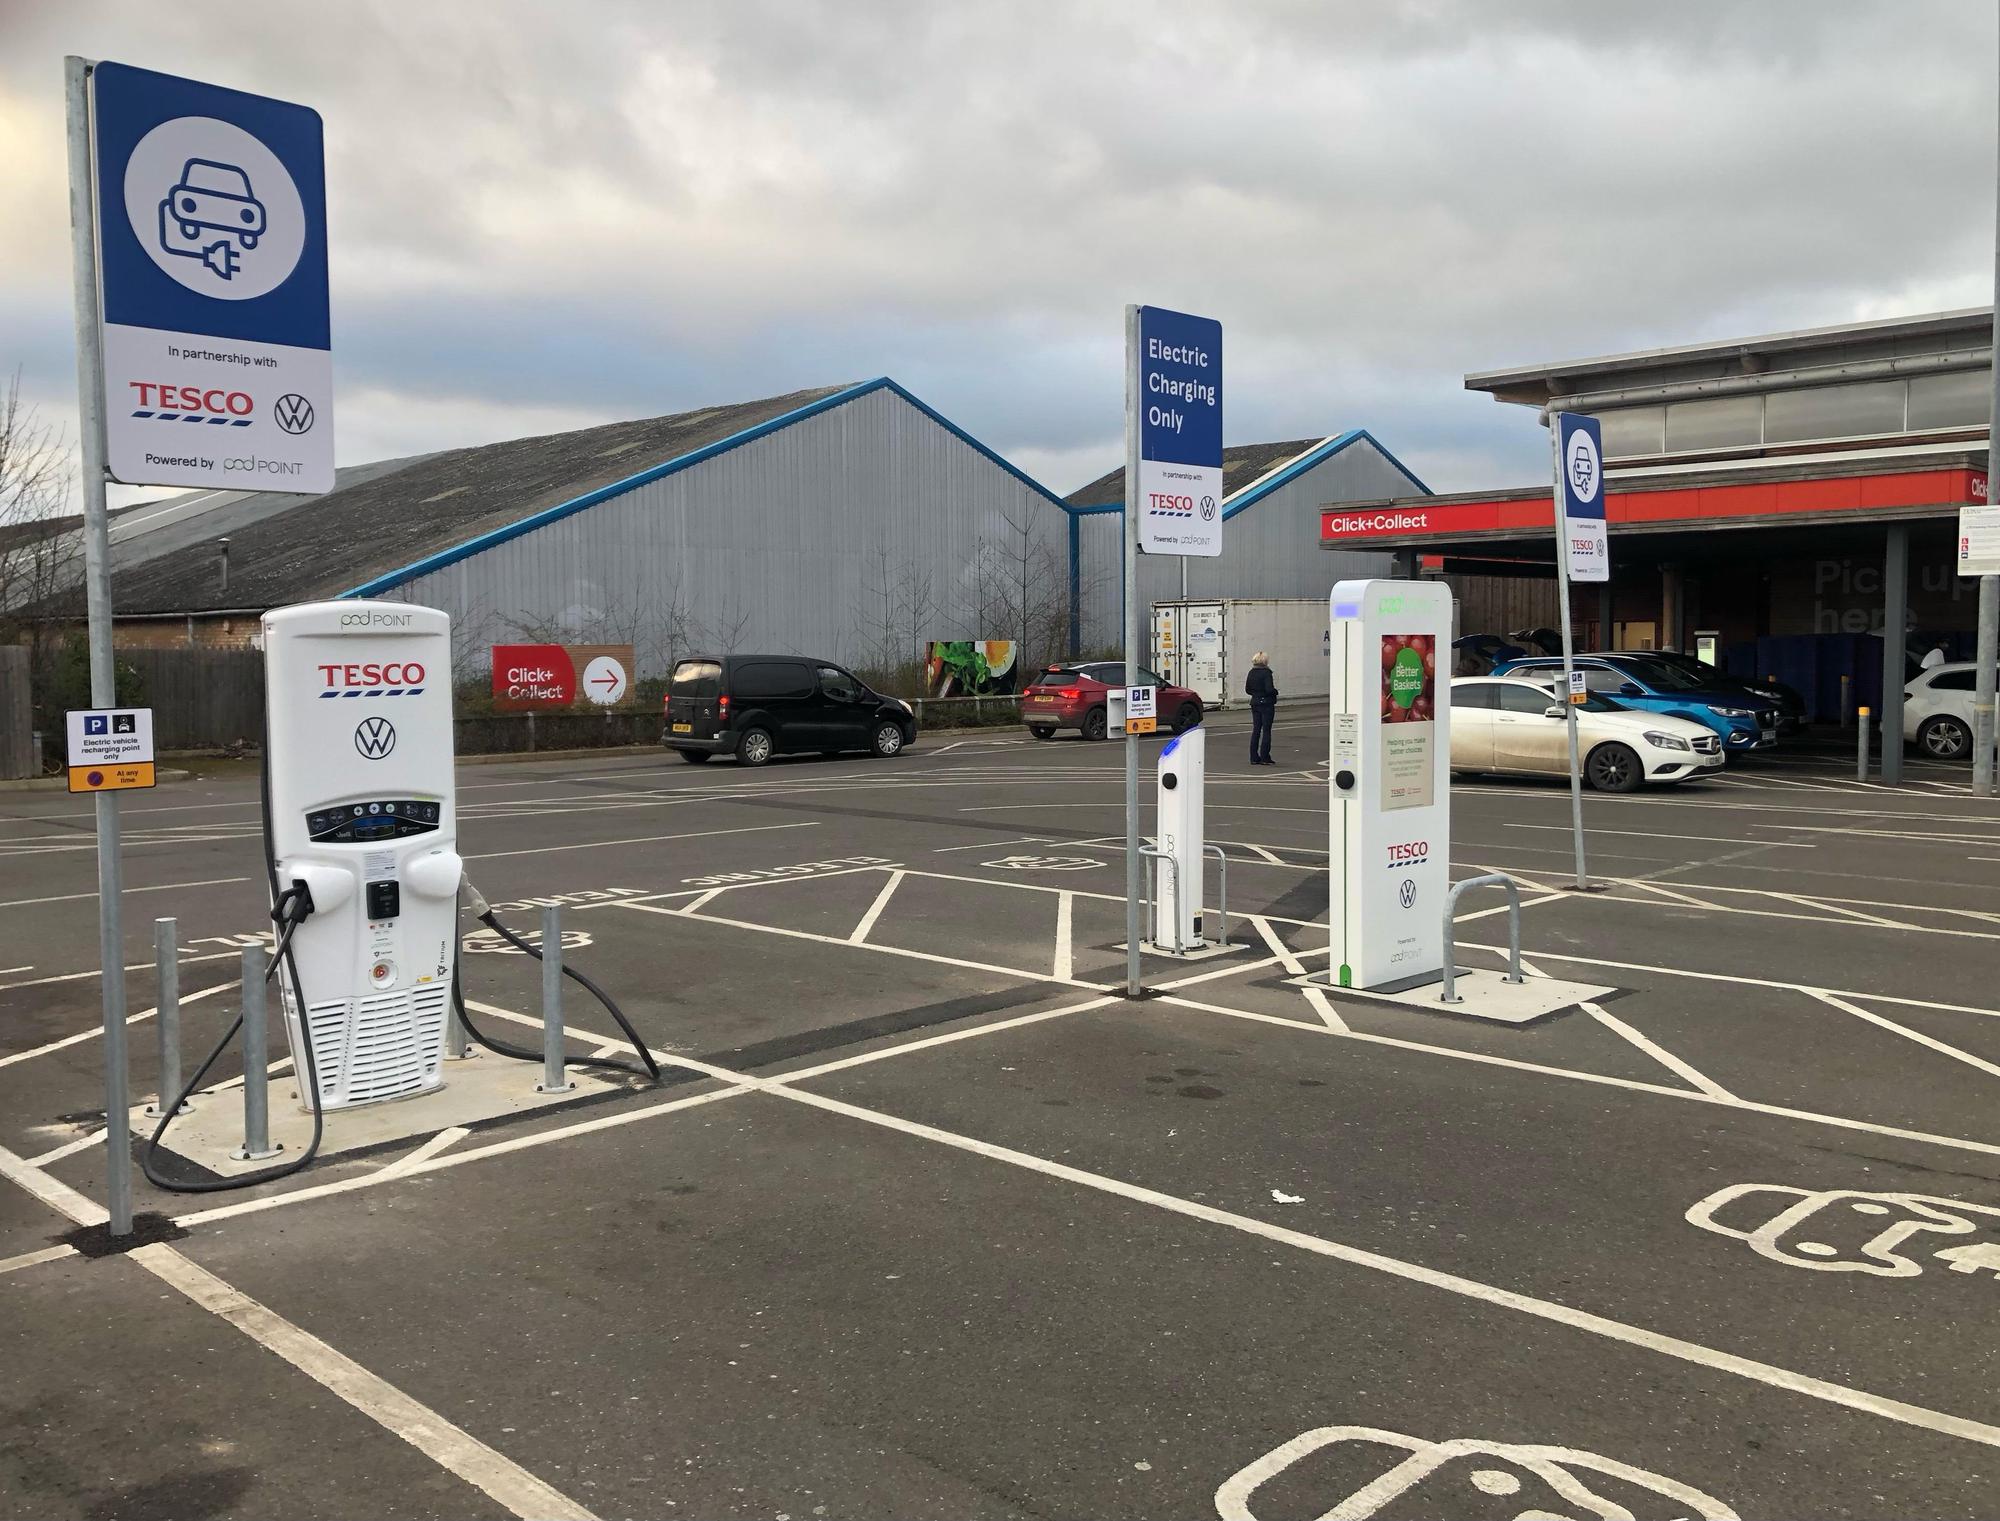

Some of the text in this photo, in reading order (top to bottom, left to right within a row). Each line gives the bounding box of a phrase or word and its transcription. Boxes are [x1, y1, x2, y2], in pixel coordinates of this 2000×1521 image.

[167, 345, 278, 368] In partnership with
[1149, 337, 1208, 368] Electric
[1148, 372, 1216, 406] Charging
[129, 381, 254, 416] TESCO
[1148, 406, 1184, 434] Only
[145, 453, 198, 468] Powered
[199, 456, 214, 471] by
[257, 459, 304, 476] POINT
[1167, 472, 1192, 481] partnership
[1149, 493, 1193, 511] TESCO
[1331, 513, 1428, 533] Click+Collect
[1153, 535, 1173, 543] Powered
[1571, 539, 1594, 551] TESCO
[1814, 559, 1886, 595] Pic
[373, 614, 413, 627] POINT
[318, 662, 426, 687] TESCO
[508, 667, 554, 683] Click+
[1395, 665, 1419, 677] Better
[508, 684, 563, 700] Collect
[1393, 679, 1421, 691] Baskets
[91, 719, 101, 731] P
[81, 744, 140, 754] recharging point
[83, 737, 138, 746] Electric vehicle
[126, 769, 139, 778] any
[1387, 841, 1428, 861] TESCO
[680, 856, 892, 886] ELECTRIC
[461, 887, 650, 913] VEHIC
